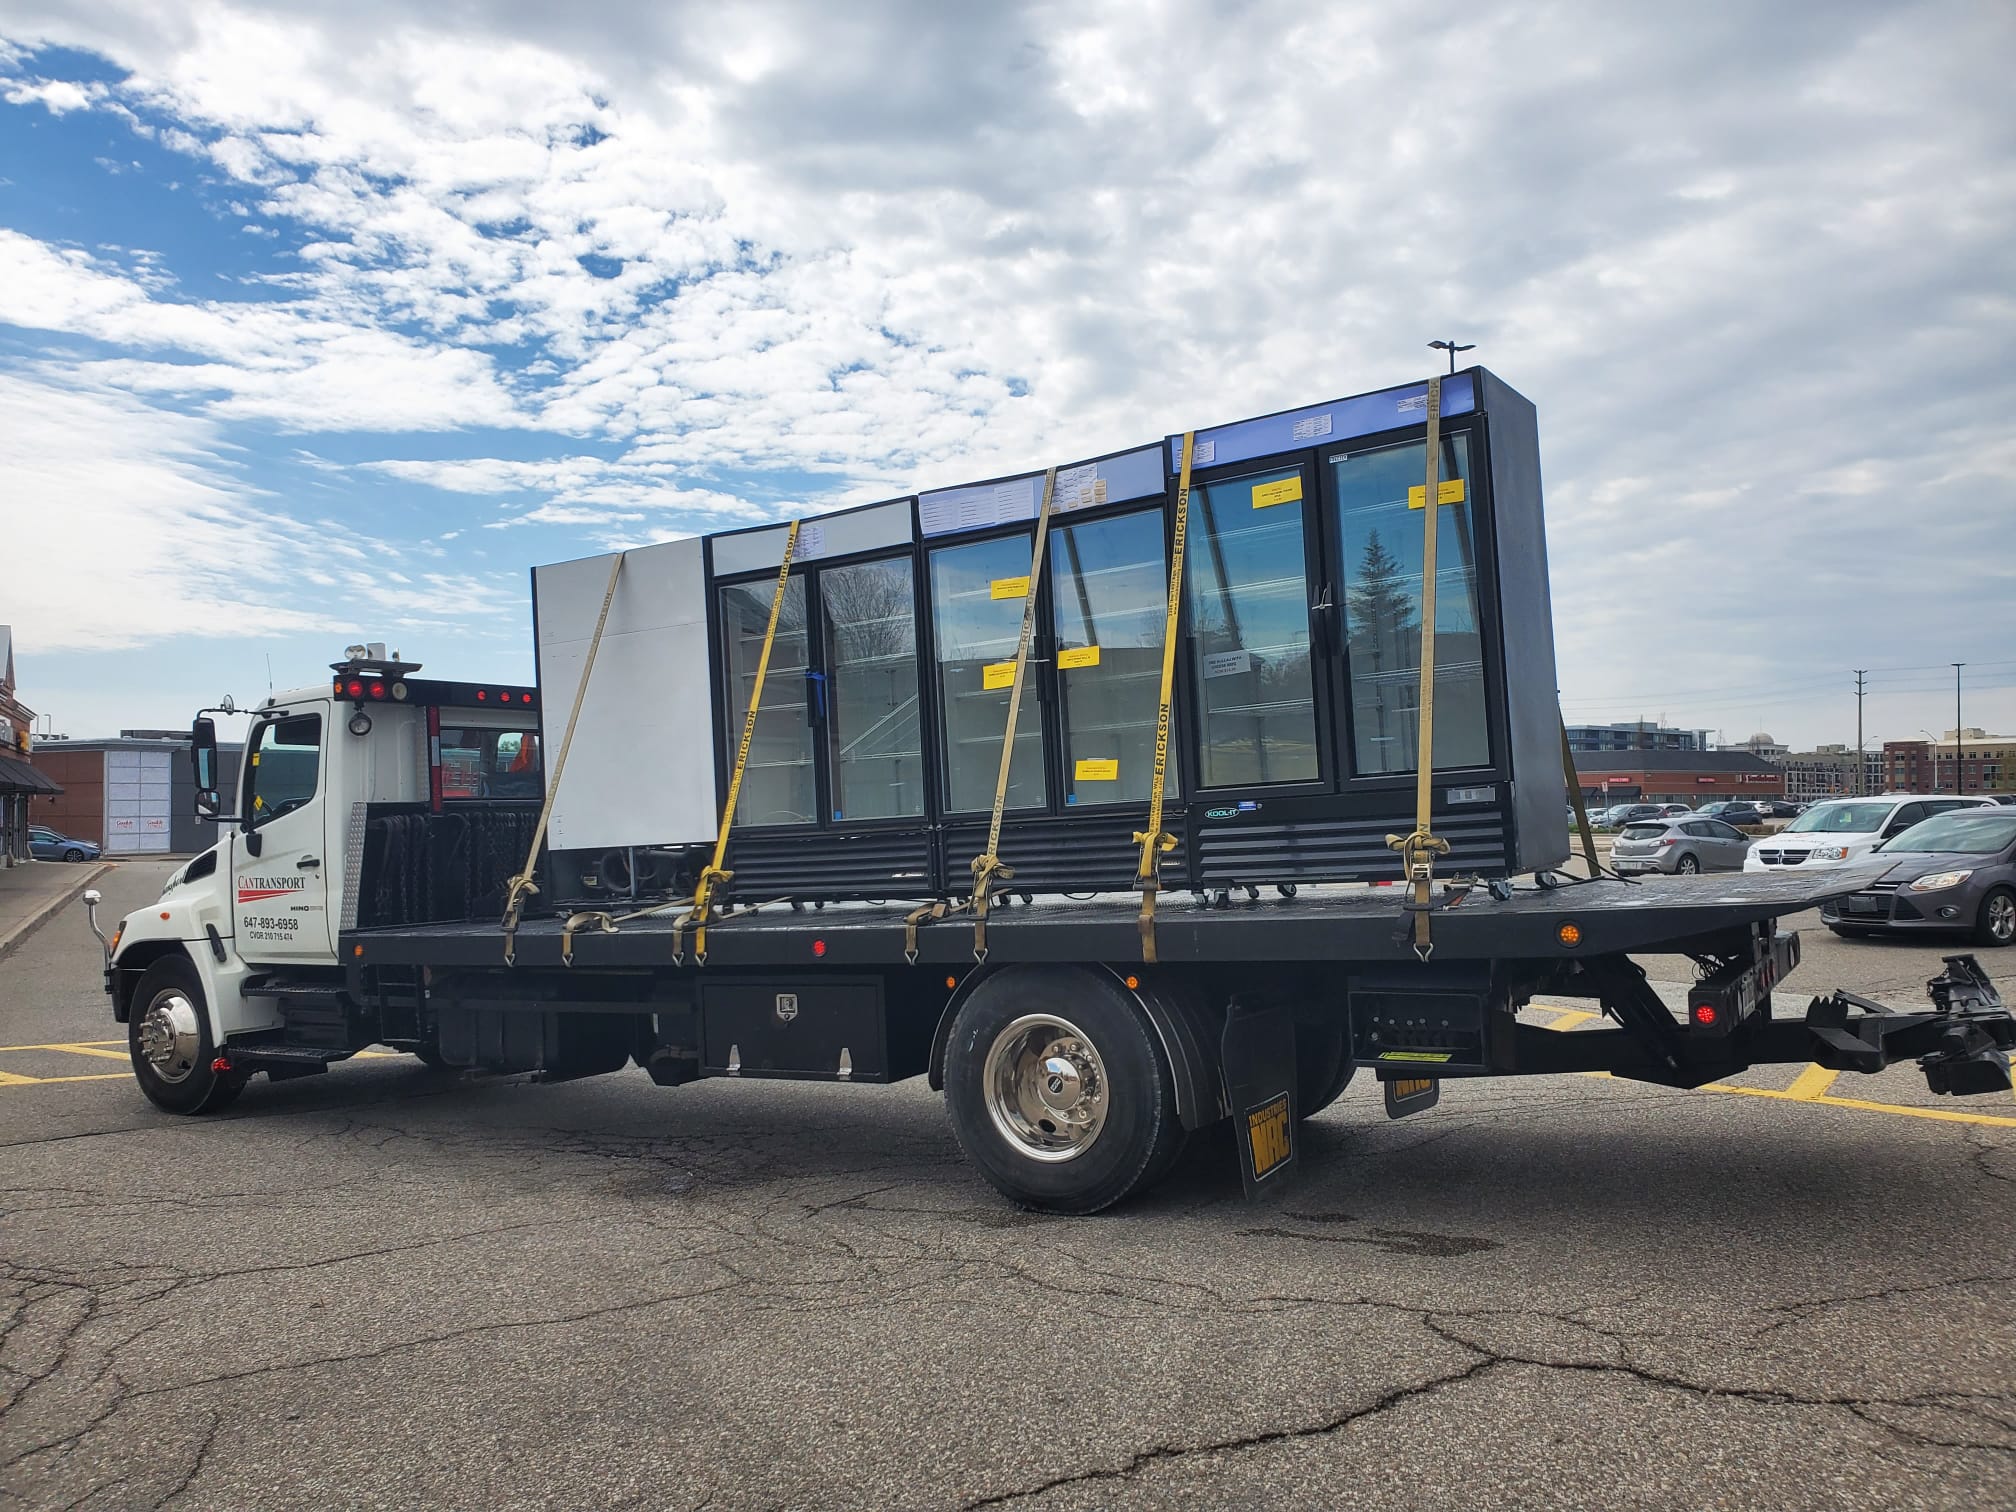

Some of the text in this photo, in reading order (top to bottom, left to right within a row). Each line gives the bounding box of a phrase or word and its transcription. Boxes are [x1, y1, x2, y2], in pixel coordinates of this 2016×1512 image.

[1174, 488, 1188, 555] ERICKSON
[778, 534, 795, 589] ERICKSON
[737, 711, 757, 770] ERICKSON
[1155, 703, 1169, 775] ERICKSON
[1208, 809, 1237, 818] KOOL-IT
[243, 916, 299, 930] 647-893-6958
[264, 932, 274, 940] 210
[1248, 1098, 1288, 1127] INDUSTRIES
